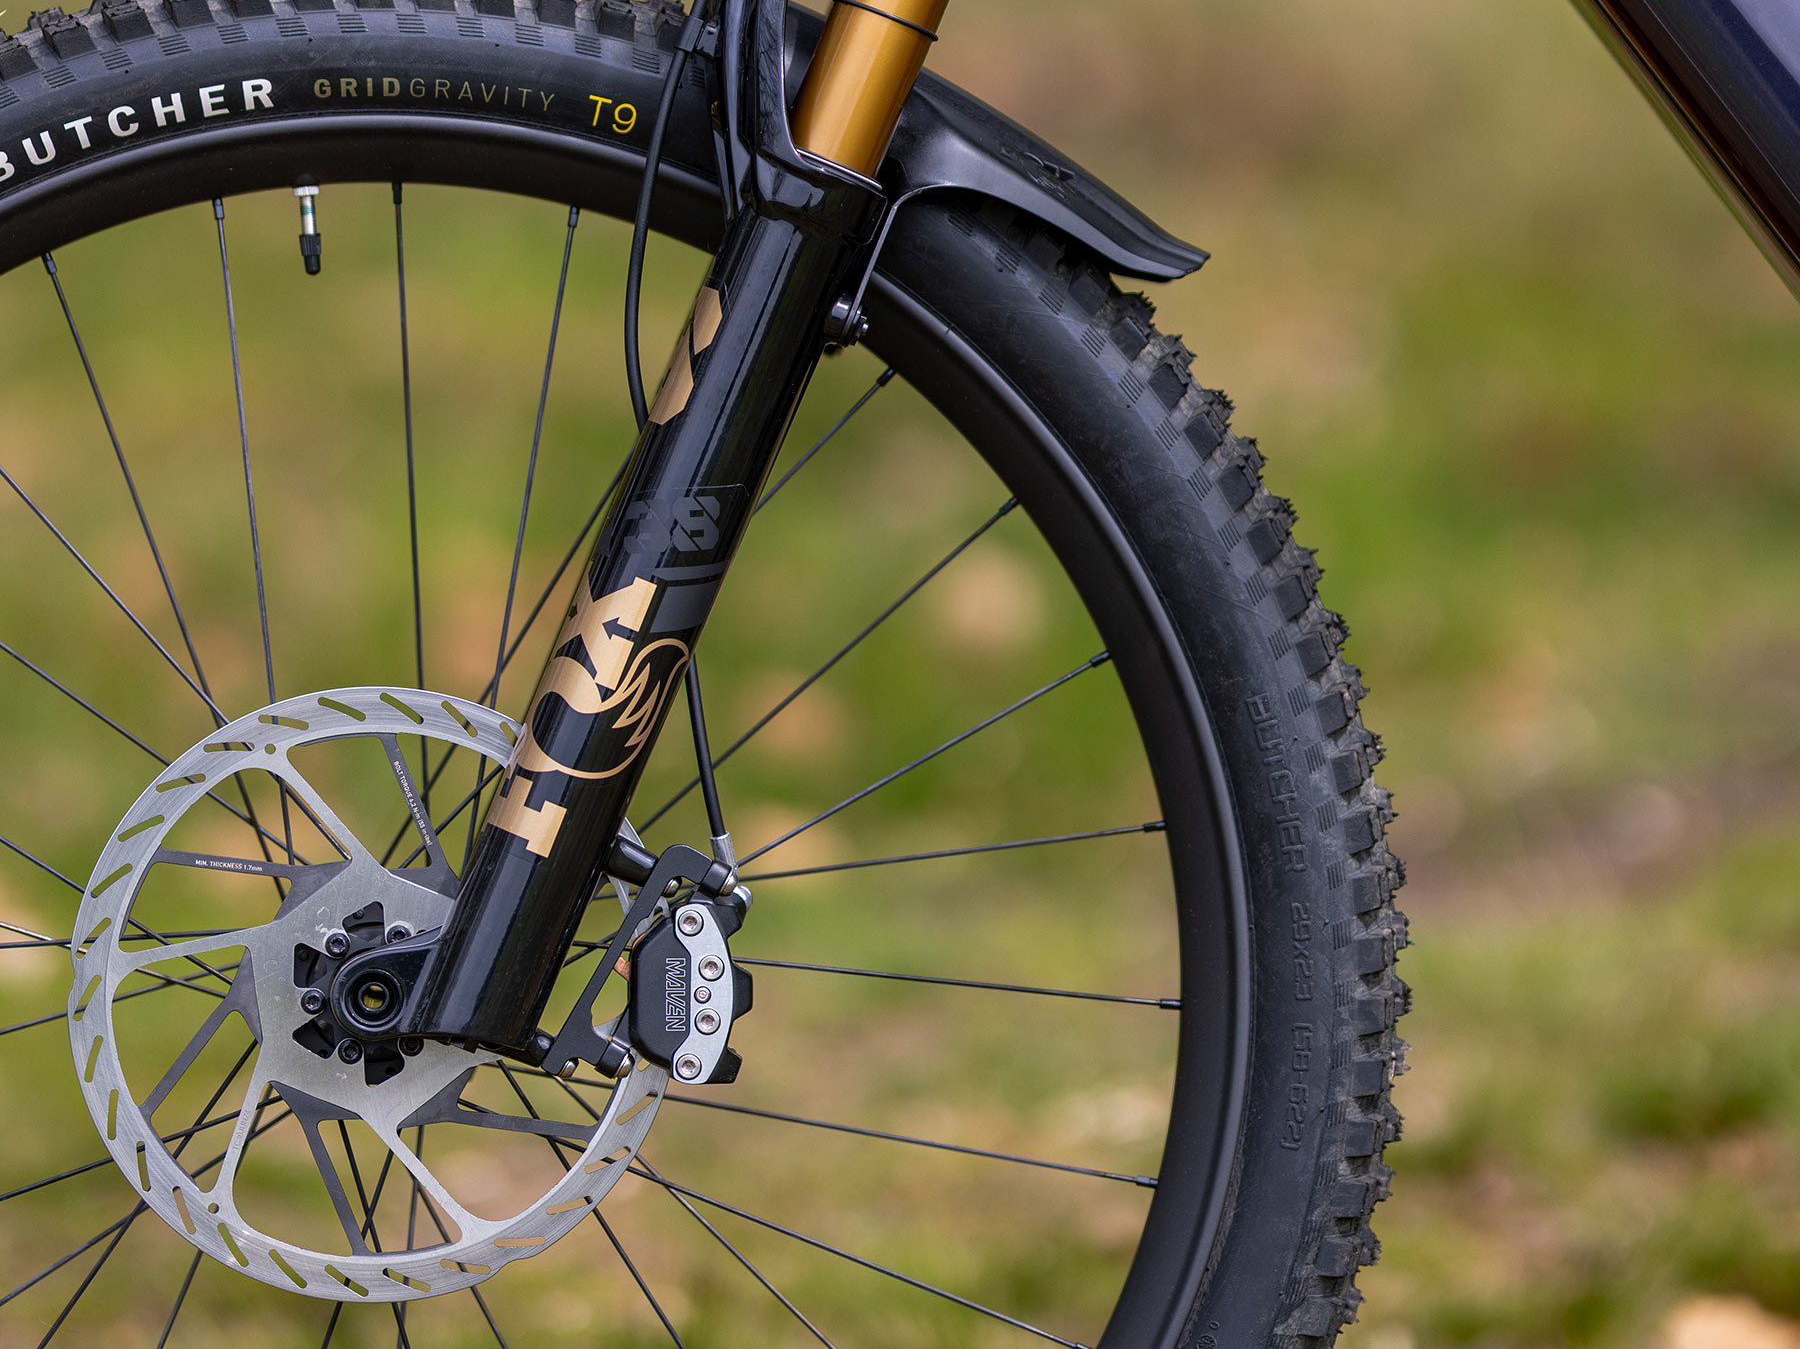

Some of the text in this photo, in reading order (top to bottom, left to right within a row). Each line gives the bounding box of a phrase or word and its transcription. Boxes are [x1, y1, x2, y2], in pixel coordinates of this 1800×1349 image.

[589, 94, 637, 134] T9
[622, 495, 720, 554] 38
[393, 760, 404, 775] BOLT
[400, 775, 413, 799] TORQUE
[1247, 692, 1308, 874] BUTCHER
[195, 859, 263, 872] MIN. THICKNESS 1.7mm
[665, 957, 686, 1032] MAVEN
